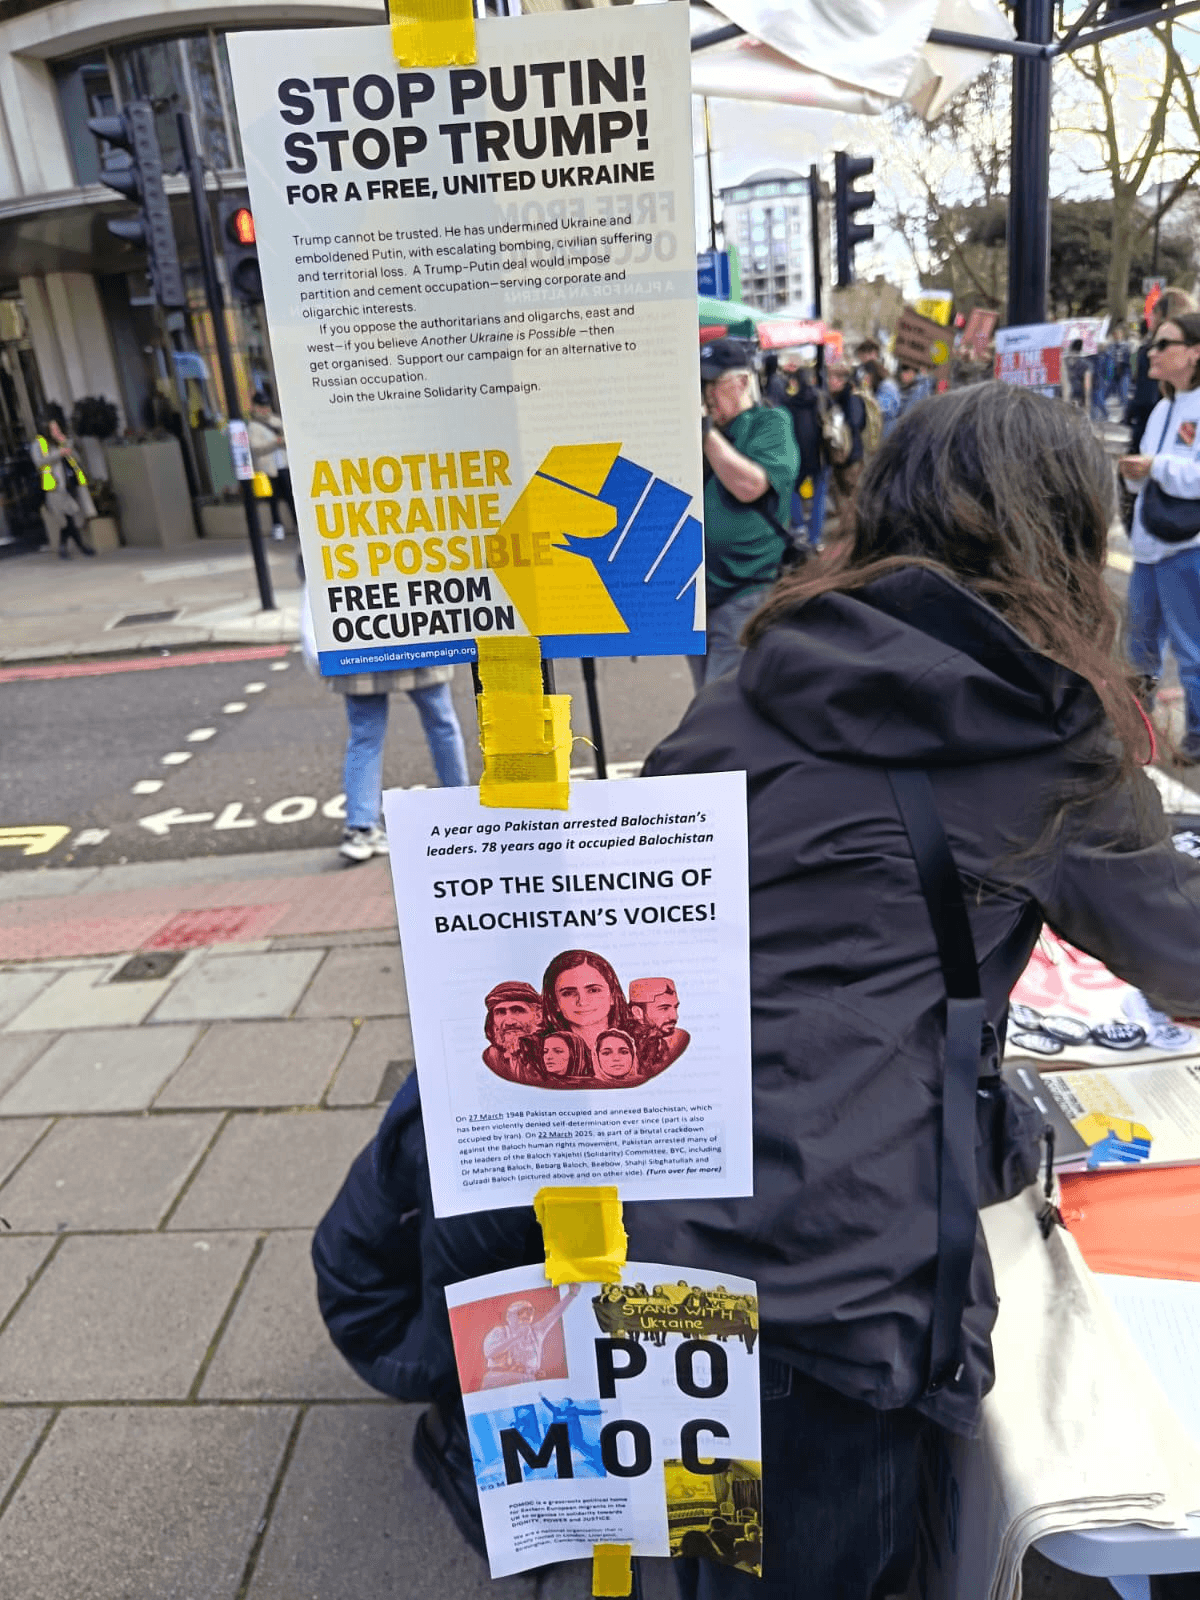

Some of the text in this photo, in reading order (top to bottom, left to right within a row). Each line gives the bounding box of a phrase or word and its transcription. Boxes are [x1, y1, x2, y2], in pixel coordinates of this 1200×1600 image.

[278, 55, 645, 125] STOP PUTIN!
[284, 108, 648, 173] STOP TRUMP!
[286, 161, 654, 204] FOR A FREE, UNITED UKRAINE
[292, 213, 631, 246] Trump cannot be trusted. He has undermined Ukraine and
[295, 232, 652, 264] emboldened Putin, with escalating bombing, civilian suffering
[298, 271, 319, 282] and
[322, 267, 377, 280] territorial
[380, 266, 406, 277] loss.
[413, 265, 421, 274] A
[502, 258, 527, 269] deal
[530, 255, 564, 267] would
[567, 254, 610, 266] impose
[300, 288, 350, 302] partition
[353, 285, 374, 297] and
[377, 284, 421, 295] cement
[544, 272, 601, 285] corporate
[604, 269, 625, 281] and
[302, 303, 416, 319] oligarchic interests.
[319, 304, 634, 336] If you oppose the authoritarians and oligarchs, east and
[354, 342, 374, 352] you
[377, 337, 417, 348] believe
[420, 334, 466, 345] Another
[469, 332, 513, 343] Ukraine
[516, 330, 525, 340] is
[528, 326, 575, 339] Possible
[309, 341, 636, 372] get organised. Support our campaign for an alternative to
[312, 371, 426, 386] Russian occupation.
[329, 382, 540, 403] Join the Ukraine Solidarity Campaign.
[310, 449, 512, 498] ANOTHER
[315, 493, 501, 539] UKRAINE
[321, 531, 553, 580] IS POSSIBLE
[327, 576, 491, 612] FREE FROM
[332, 605, 514, 642] OCCUPATION
[340, 647, 475, 664] ukrainesolidaritycampaign.org
[431, 811, 705, 837] A year ago Pakistan arrested Balochistan's
[427, 833, 713, 856] leaders. 78 years ago it occupied Balochistan
[433, 868, 711, 898] STOP THE SILENCING OF
[435, 902, 715, 932] BALOCHISTAN'S VOICES!
[480, 1112, 503, 1121] March
[622, 1304, 679, 1316] STAND
[684, 1304, 734, 1321] WITH
[640, 1317, 704, 1330] Ukraine
